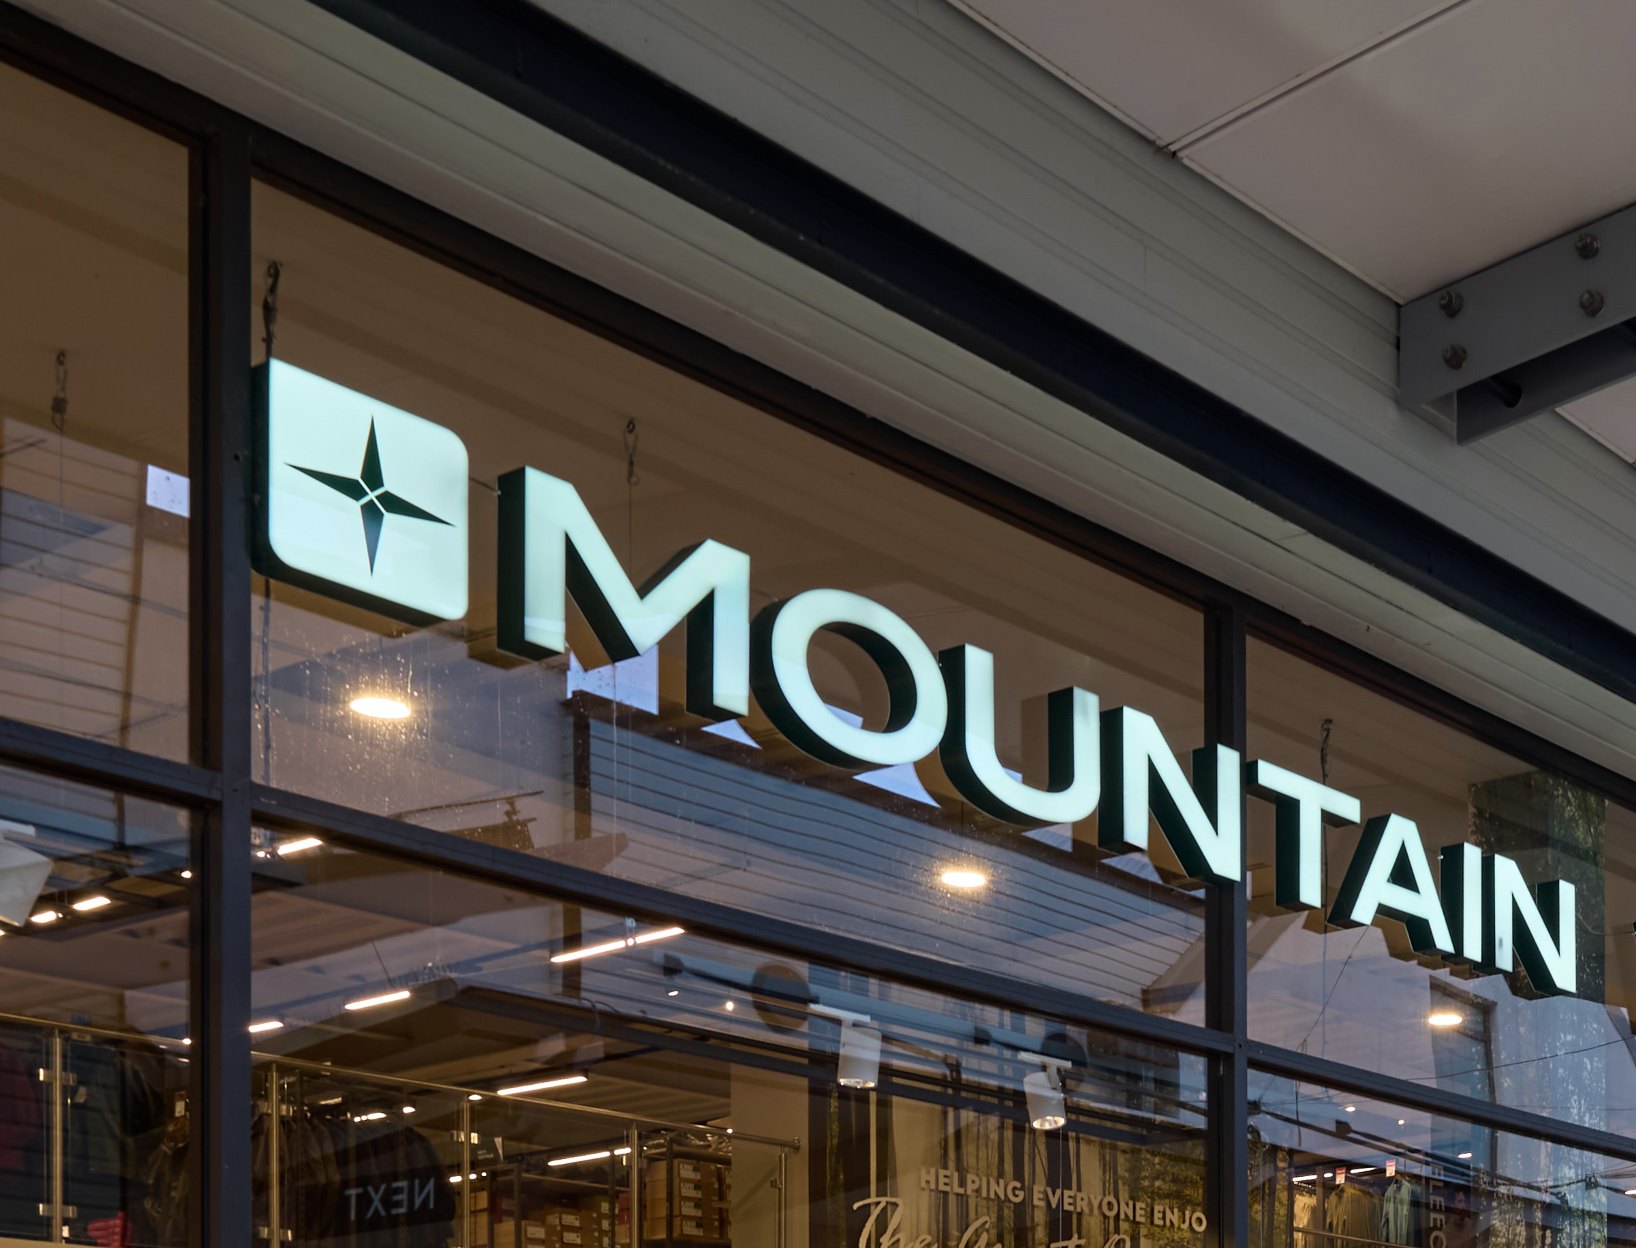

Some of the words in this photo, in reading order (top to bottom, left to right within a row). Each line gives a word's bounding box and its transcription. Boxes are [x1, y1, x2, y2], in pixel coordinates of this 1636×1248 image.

[500, 466, 1576, 995] MOUNTAIN
[919, 1167, 1026, 1205] HELPING
[1032, 1186, 1145, 1224] EVERYONE
[1153, 1204, 1207, 1233] ENJO
